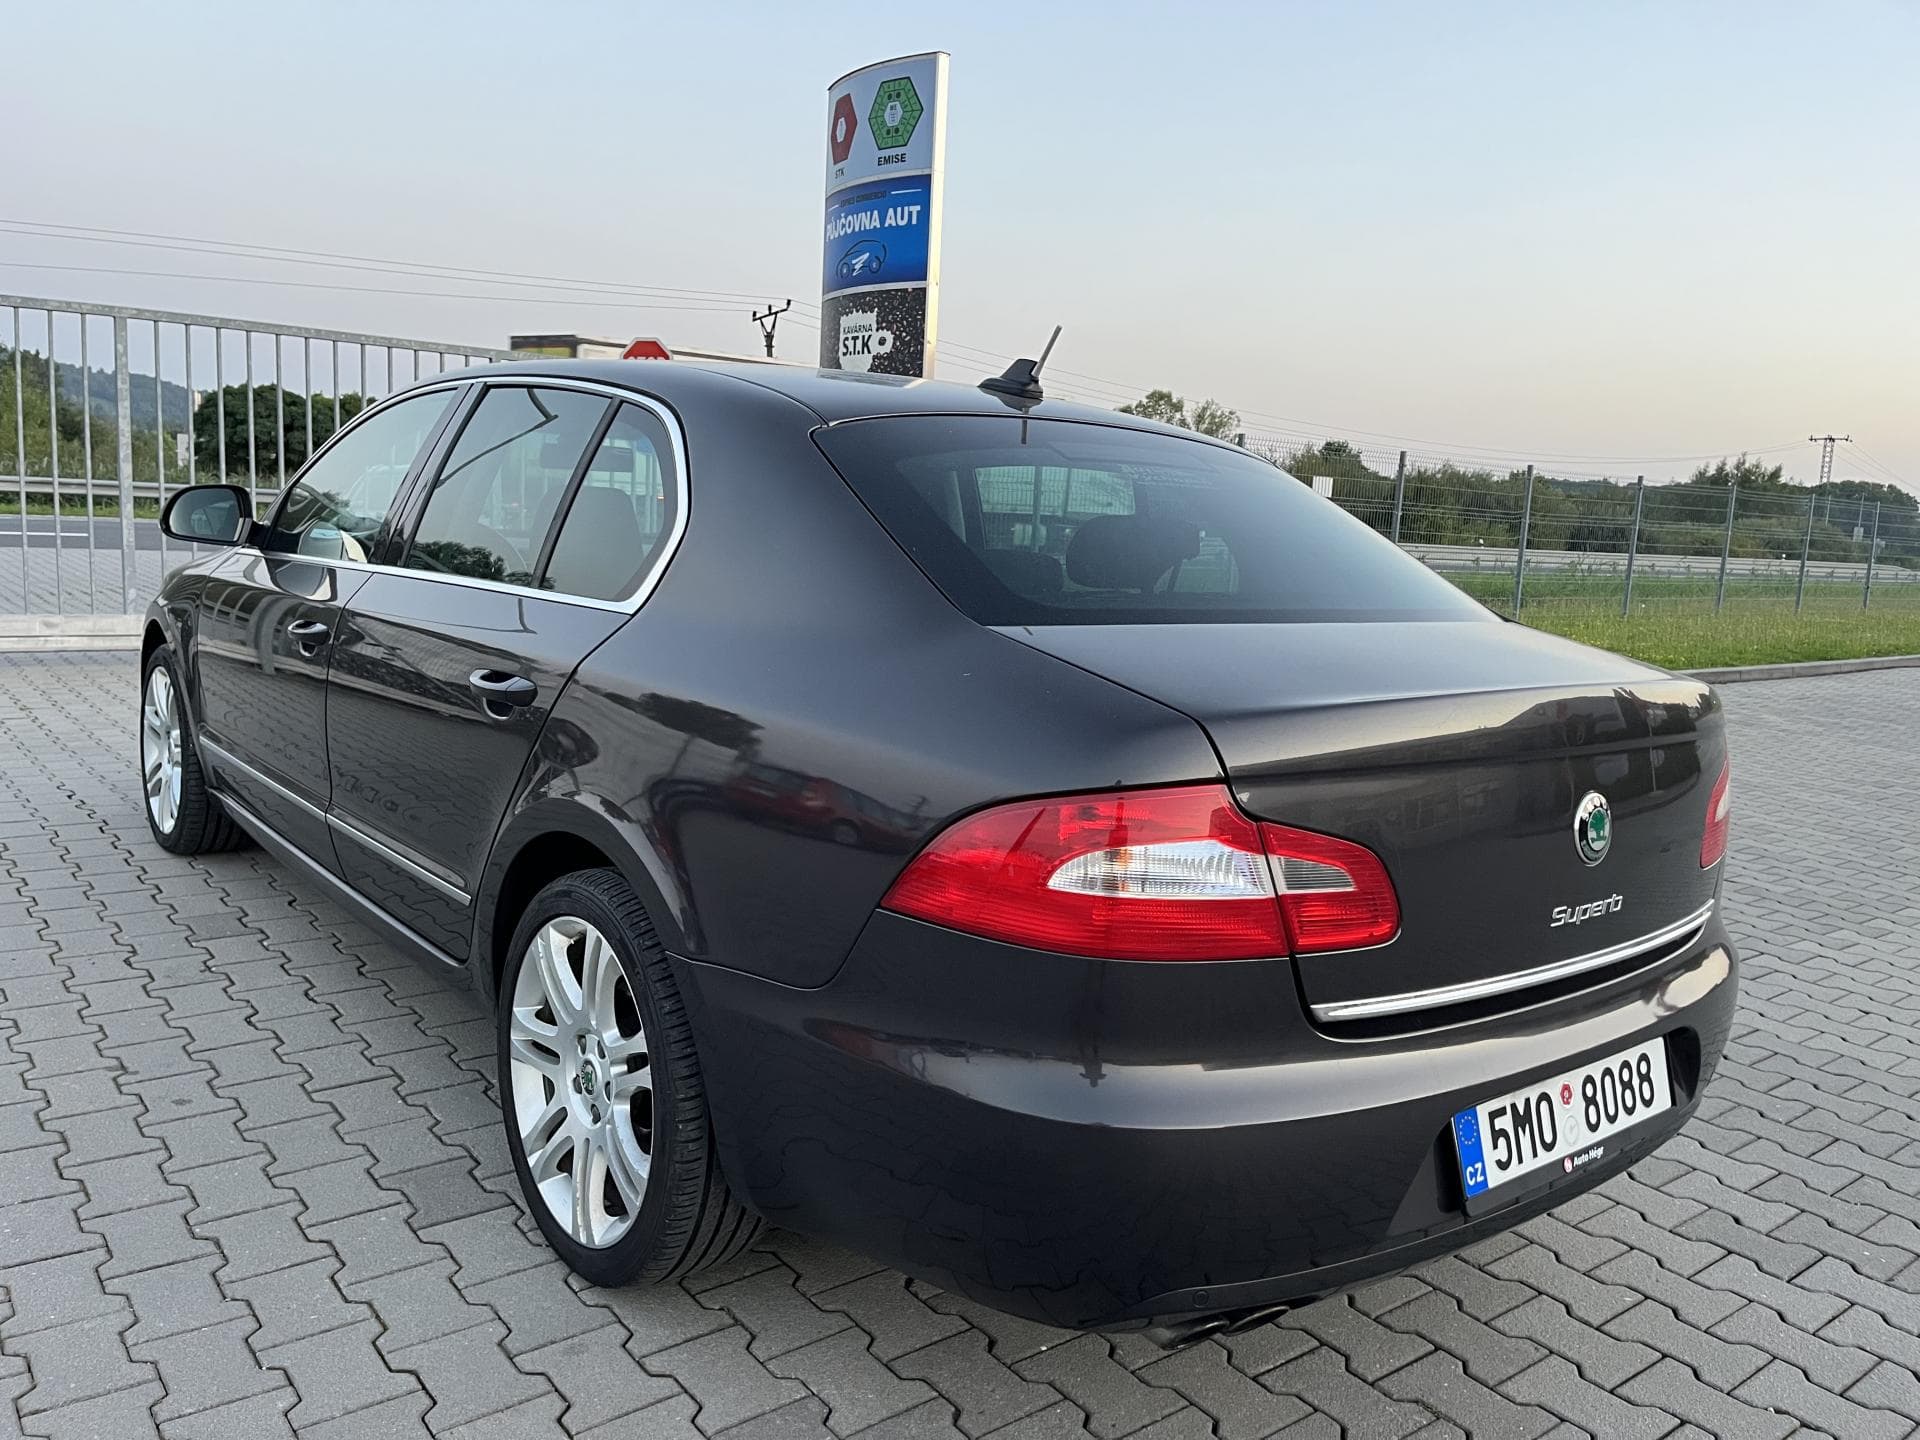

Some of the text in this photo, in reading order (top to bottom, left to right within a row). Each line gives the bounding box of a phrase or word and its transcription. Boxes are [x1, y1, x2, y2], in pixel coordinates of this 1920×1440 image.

[877, 153, 907, 167] EMISE
[884, 205, 921, 227] AUT
[842, 323, 873, 335] KAVÁRNA
[842, 334, 873, 357] S.T.K
[1550, 893, 1624, 928] Superb
[1581, 1052, 1655, 1134] 8088
[1573, 1153, 1589, 1168] Auto
[1465, 1162, 1485, 1186] CZ
